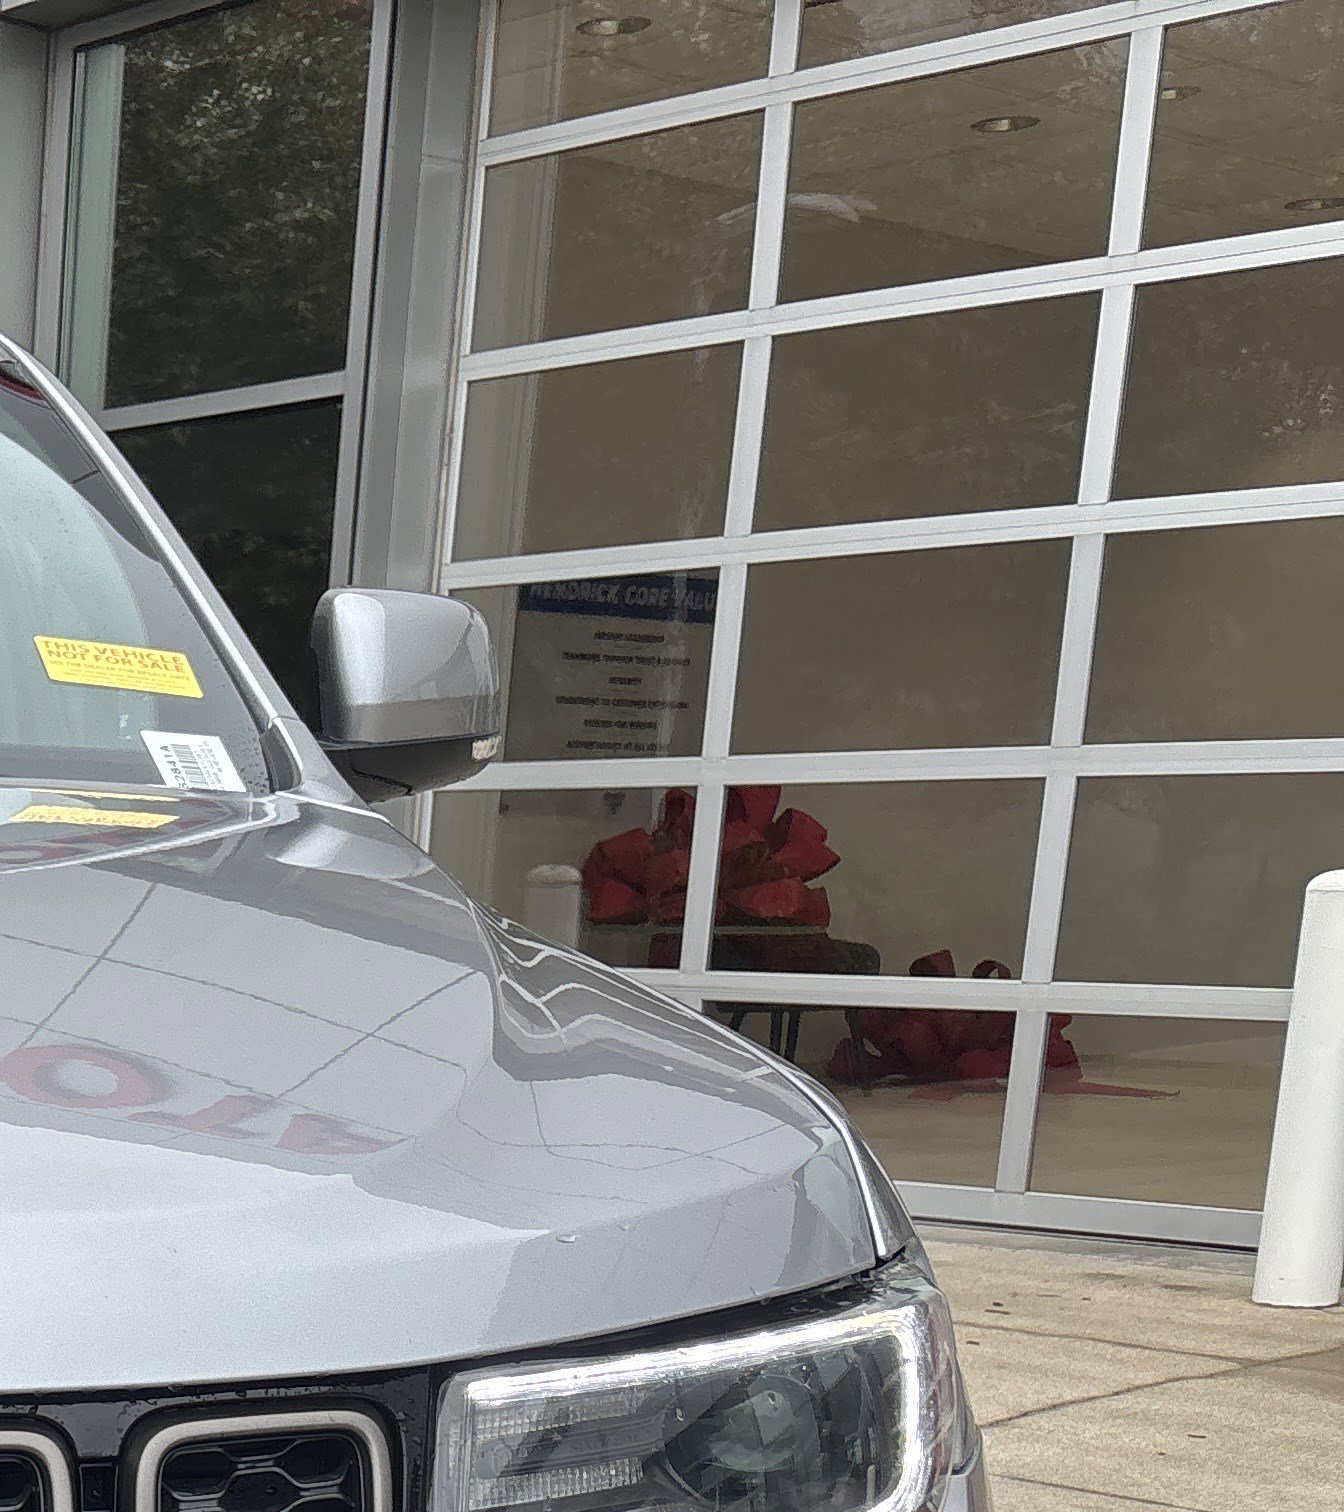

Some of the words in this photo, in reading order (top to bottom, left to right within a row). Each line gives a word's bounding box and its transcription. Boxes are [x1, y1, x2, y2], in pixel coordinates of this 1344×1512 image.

[42, 640, 90, 653] THIS
[95, 647, 182, 663] VEHICLE
[47, 650, 88, 662] NOT
[93, 655, 132, 667] FOR
[137, 661, 186, 672] SALE
